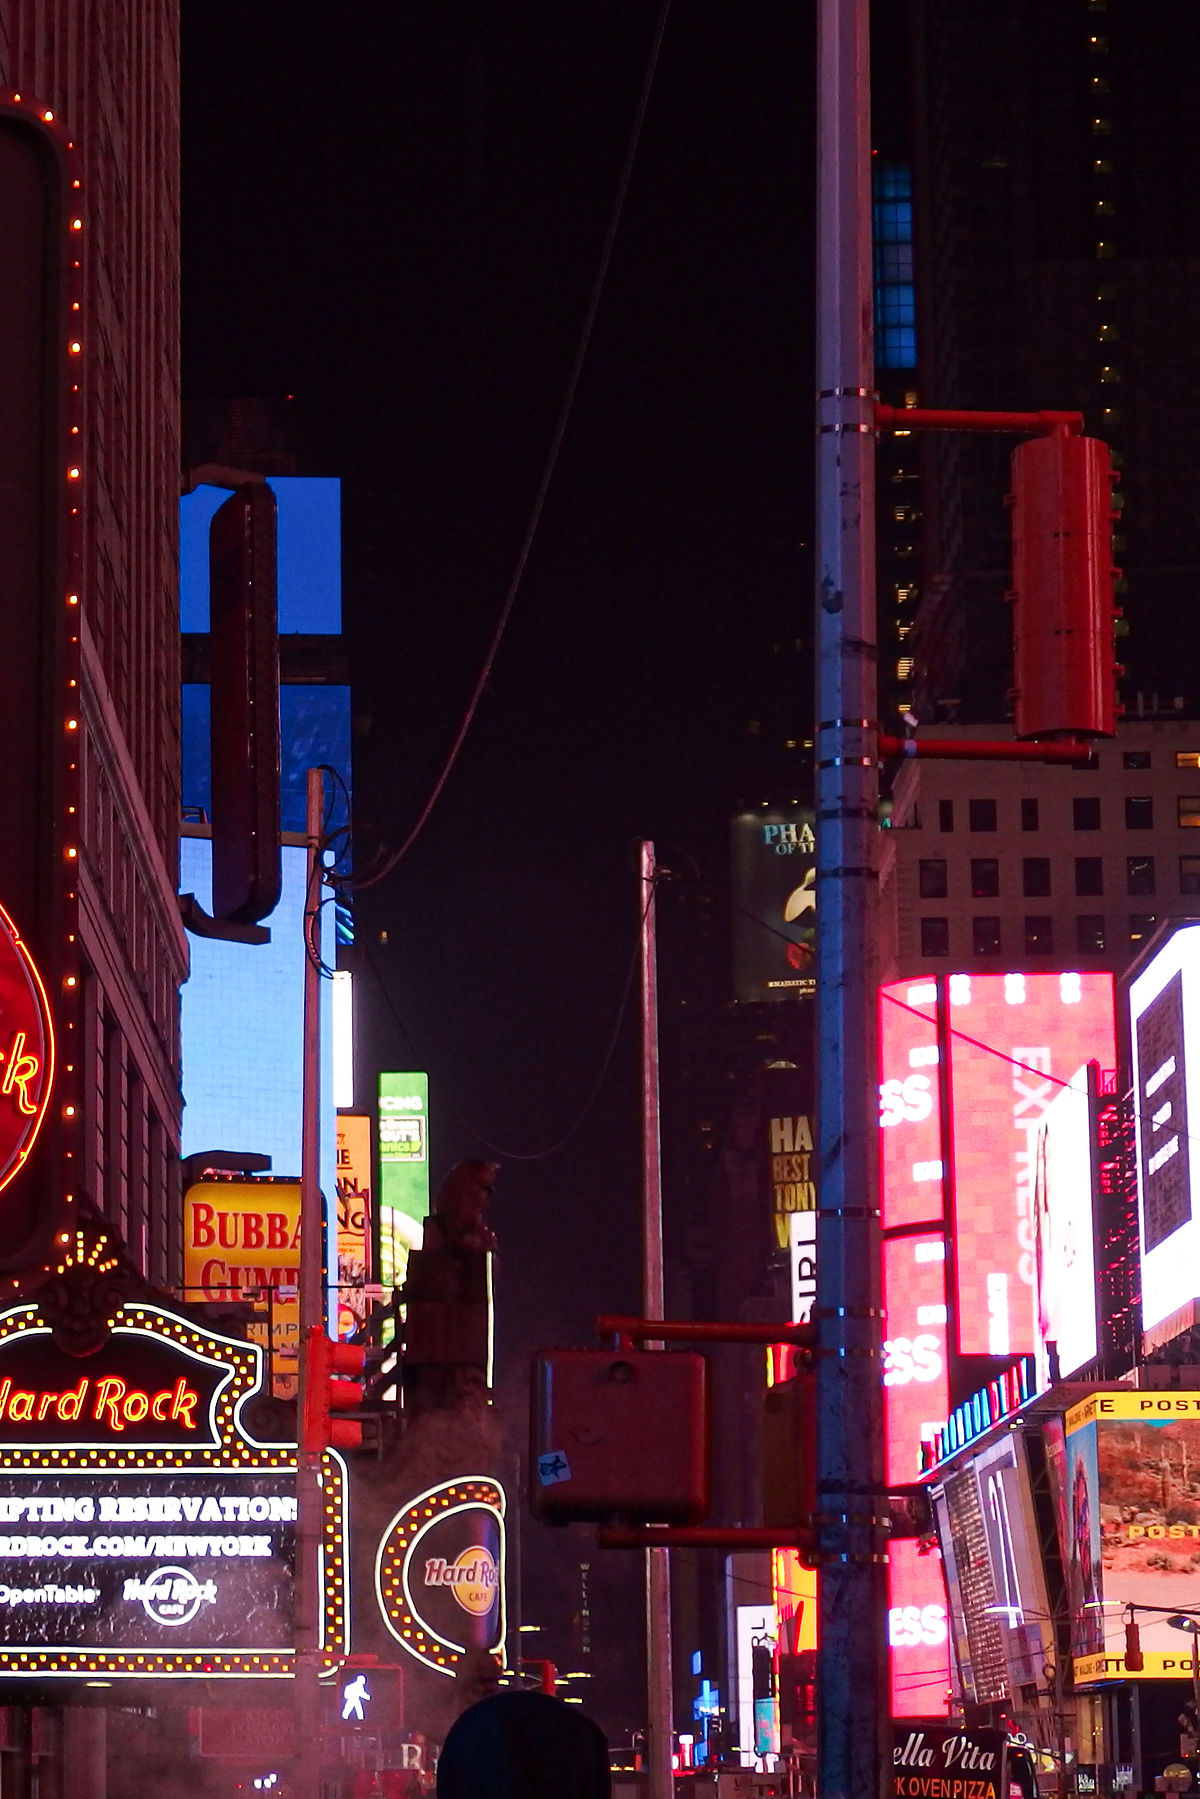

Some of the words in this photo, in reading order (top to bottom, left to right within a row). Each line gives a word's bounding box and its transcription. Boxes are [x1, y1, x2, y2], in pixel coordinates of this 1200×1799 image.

[773, 1154, 811, 1182] BEST
[96, 1378, 198, 1431] Rock
[98, 1496, 298, 1523] RESERVATION
[426, 1558, 477, 1586] Hard
[123, 1578, 171, 1601] Hard
[171, 1578, 218, 1604] Rock
[469, 1591, 488, 1603] CAFE
[159, 1603, 185, 1616] CAFE
[942, 1735, 997, 1771] Vita
[908, 1776, 951, 1799] OVEN
[953, 1779, 997, 1799] PIZZA
